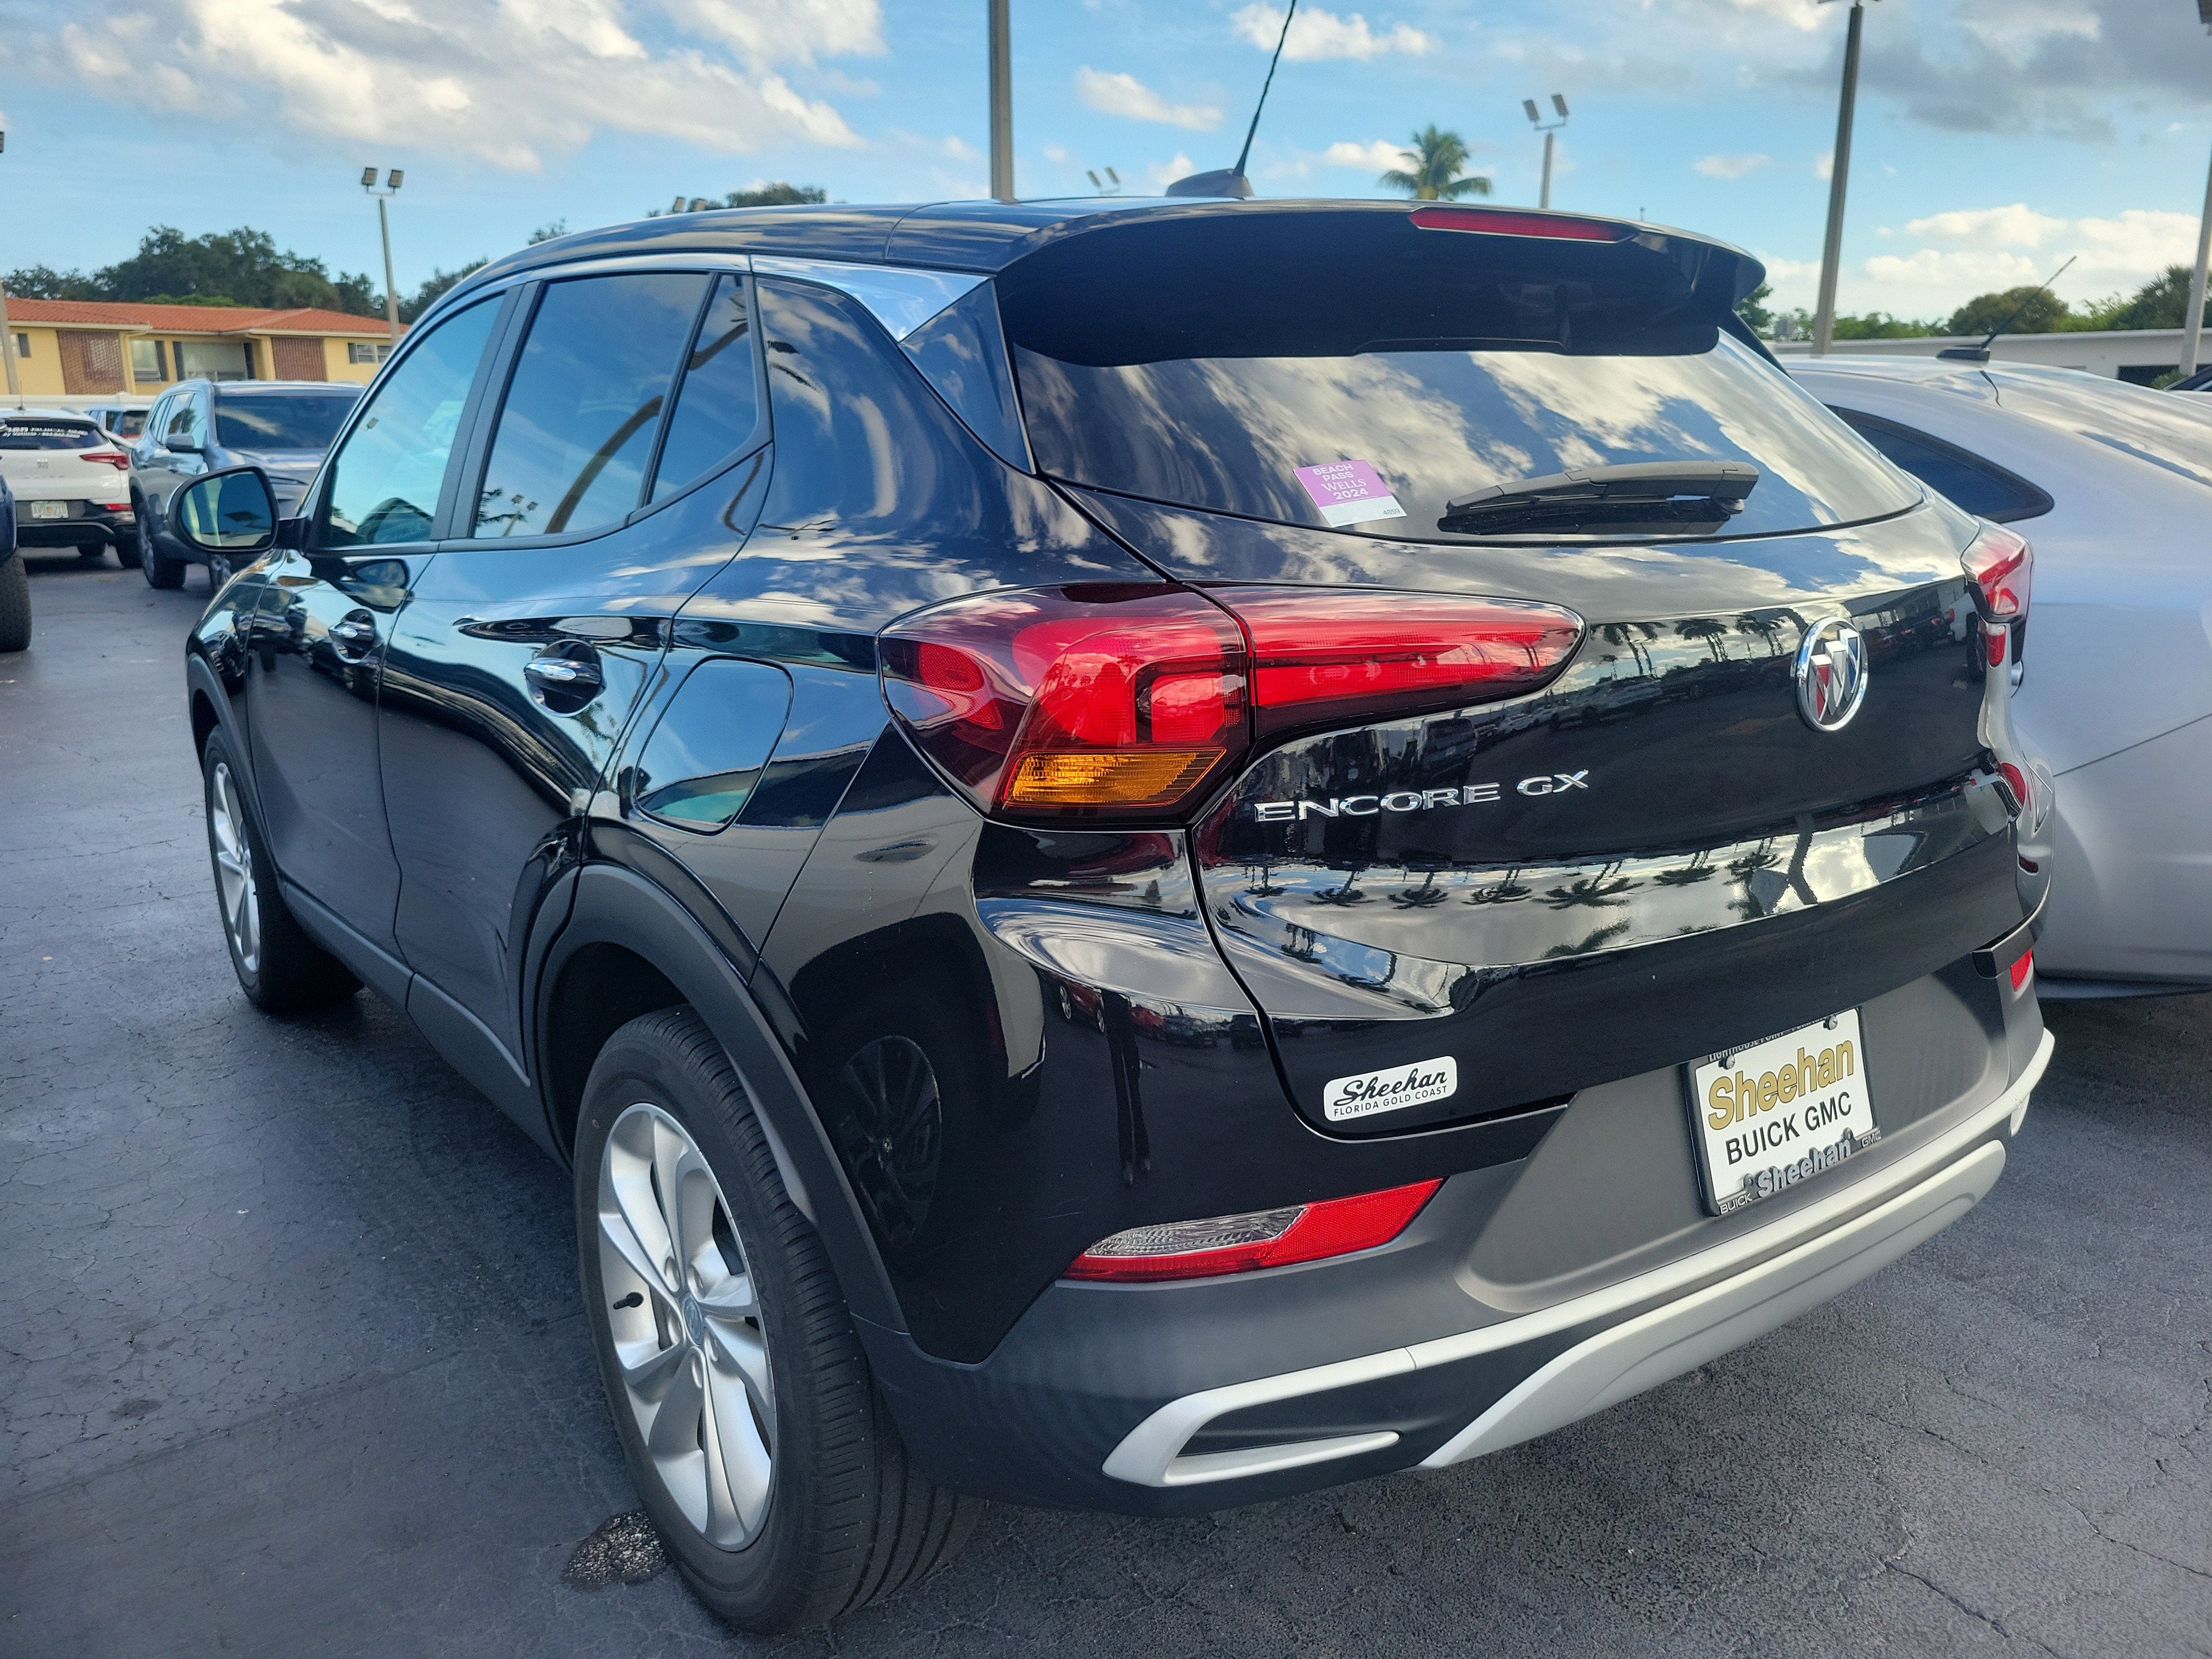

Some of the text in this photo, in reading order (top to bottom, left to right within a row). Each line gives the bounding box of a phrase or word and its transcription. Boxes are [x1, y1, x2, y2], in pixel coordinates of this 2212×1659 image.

[1312, 464, 1354, 475] BEACH
[1321, 478, 1367, 492] WELLS
[1322, 472, 1354, 482] PASS
[1333, 488, 1368, 500] 2024
[1254, 769, 1589, 823] ENCORE GX
[1333, 1068, 1448, 1107] Sheehan
[1334, 1085, 1447, 1117] FLORIDA GOLD COAST
[1708, 1040, 1854, 1130] Sheehan
[1725, 1091, 1852, 1165] BUICK GMC
[1720, 1130, 1882, 1215] BUICK Sheehan GMC
